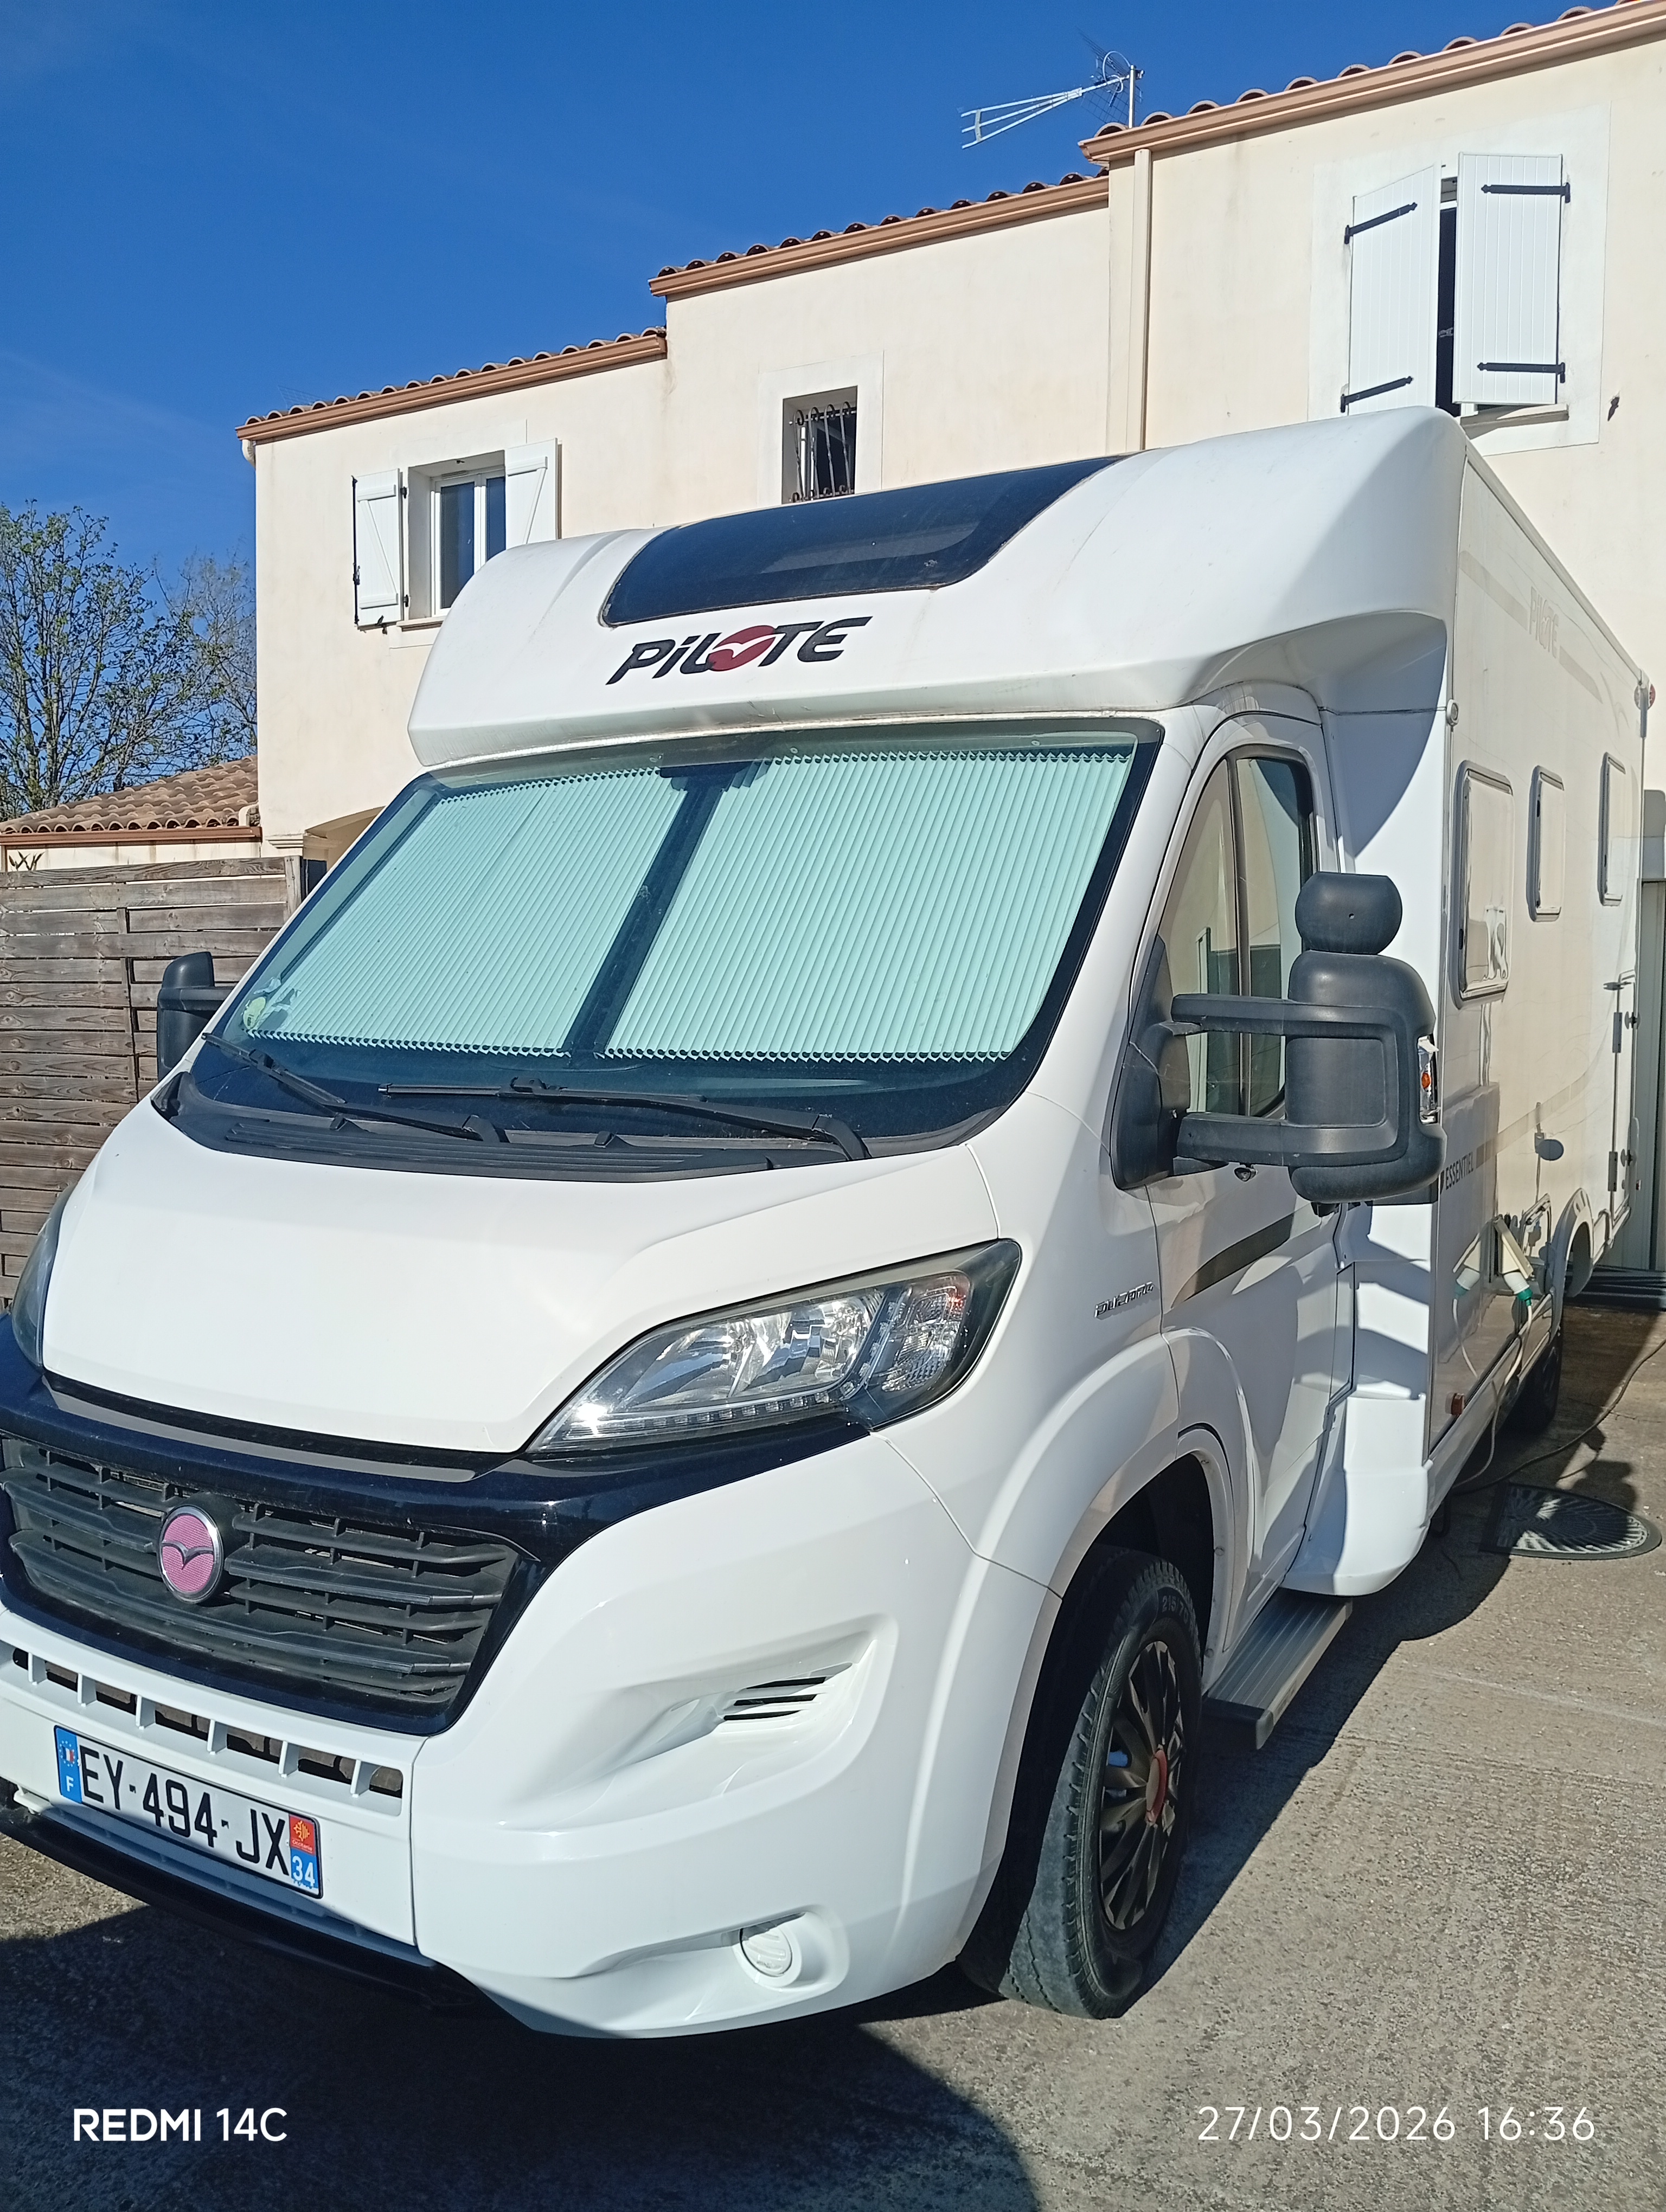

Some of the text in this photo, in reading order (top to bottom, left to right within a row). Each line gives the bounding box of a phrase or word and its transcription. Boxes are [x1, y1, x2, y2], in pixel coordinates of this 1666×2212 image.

[1445, 1151, 1474, 1191] ESSENTIEL
[66, 1775, 74, 1792] F
[292, 1855, 315, 1887] 34
